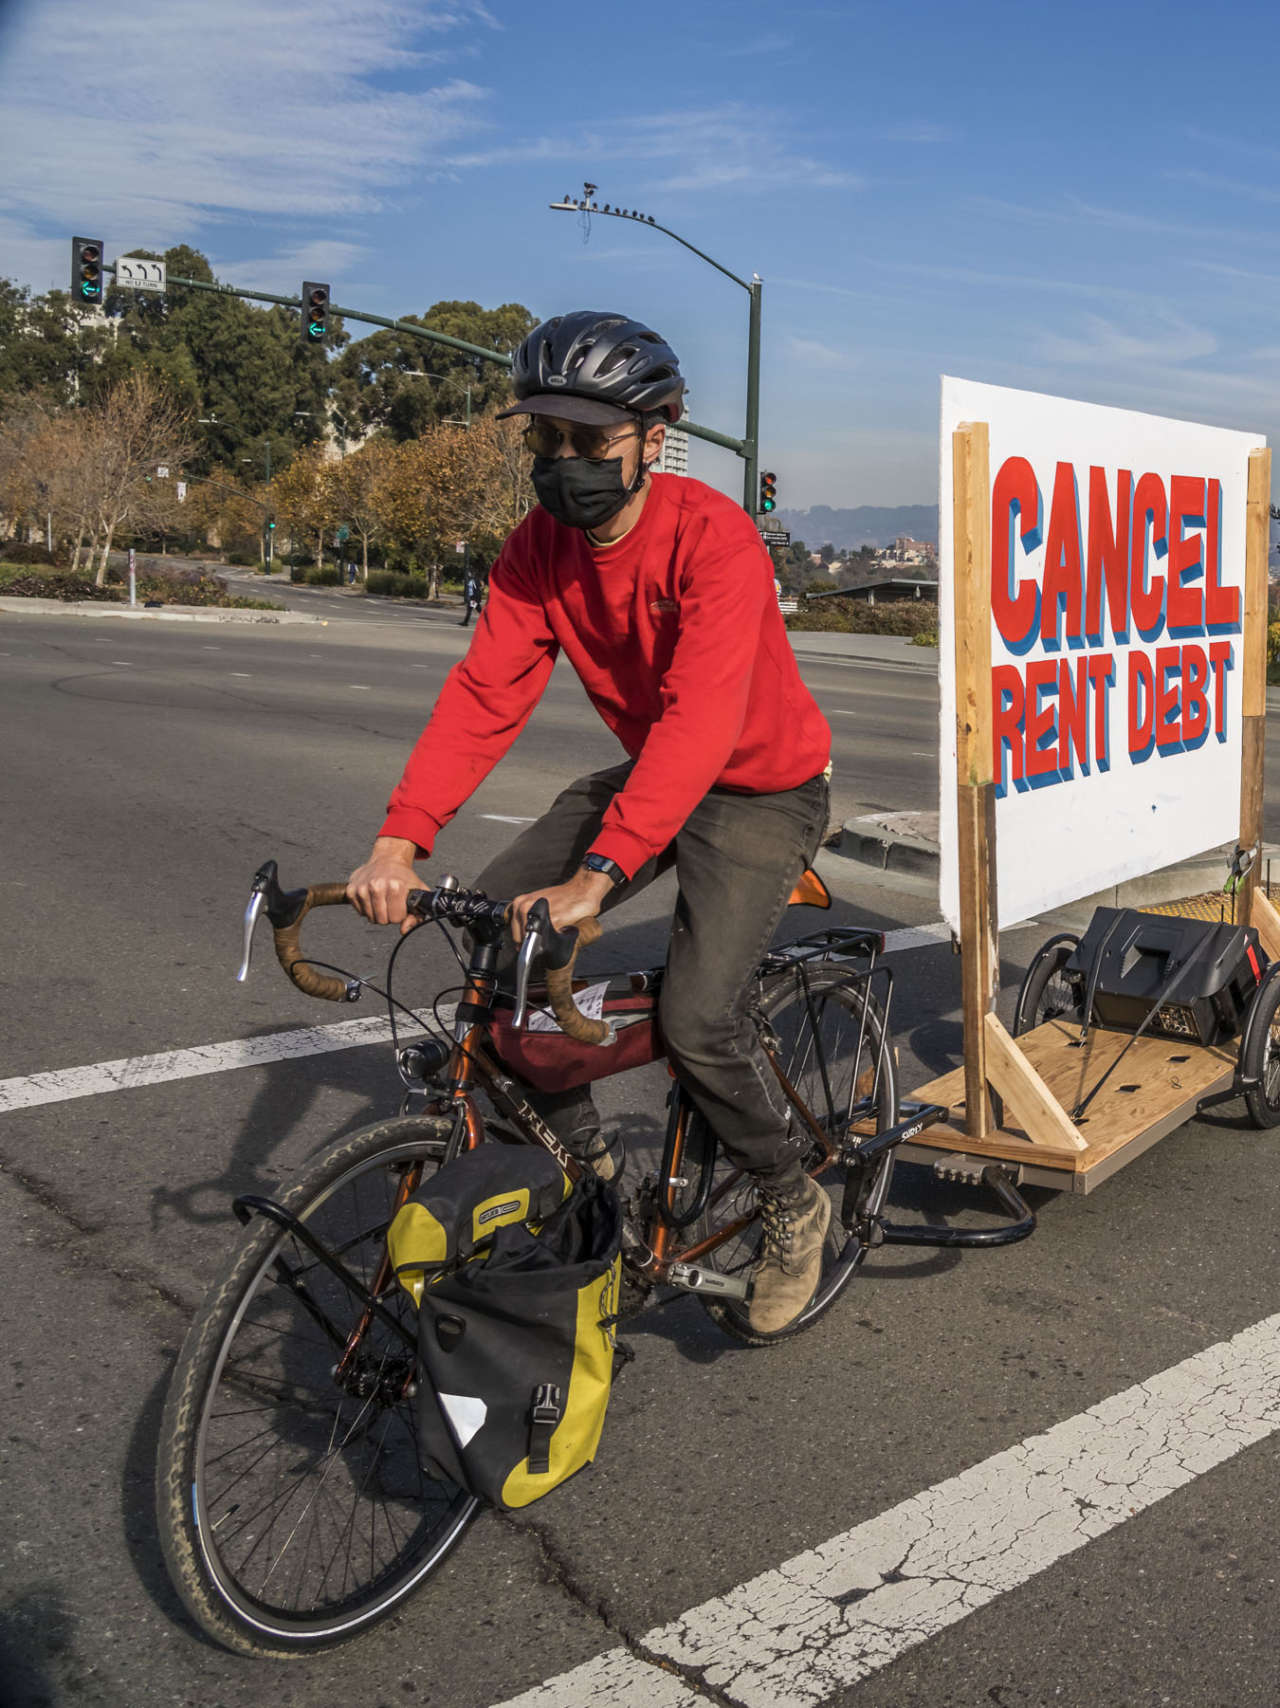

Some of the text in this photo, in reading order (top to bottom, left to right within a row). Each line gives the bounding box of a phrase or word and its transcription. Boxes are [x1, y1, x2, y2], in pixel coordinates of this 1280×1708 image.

[991, 456, 1242, 656] CANCEL
[992, 641, 1236, 799] RENT DEBT
[517, 1098, 573, 1169] TREK
